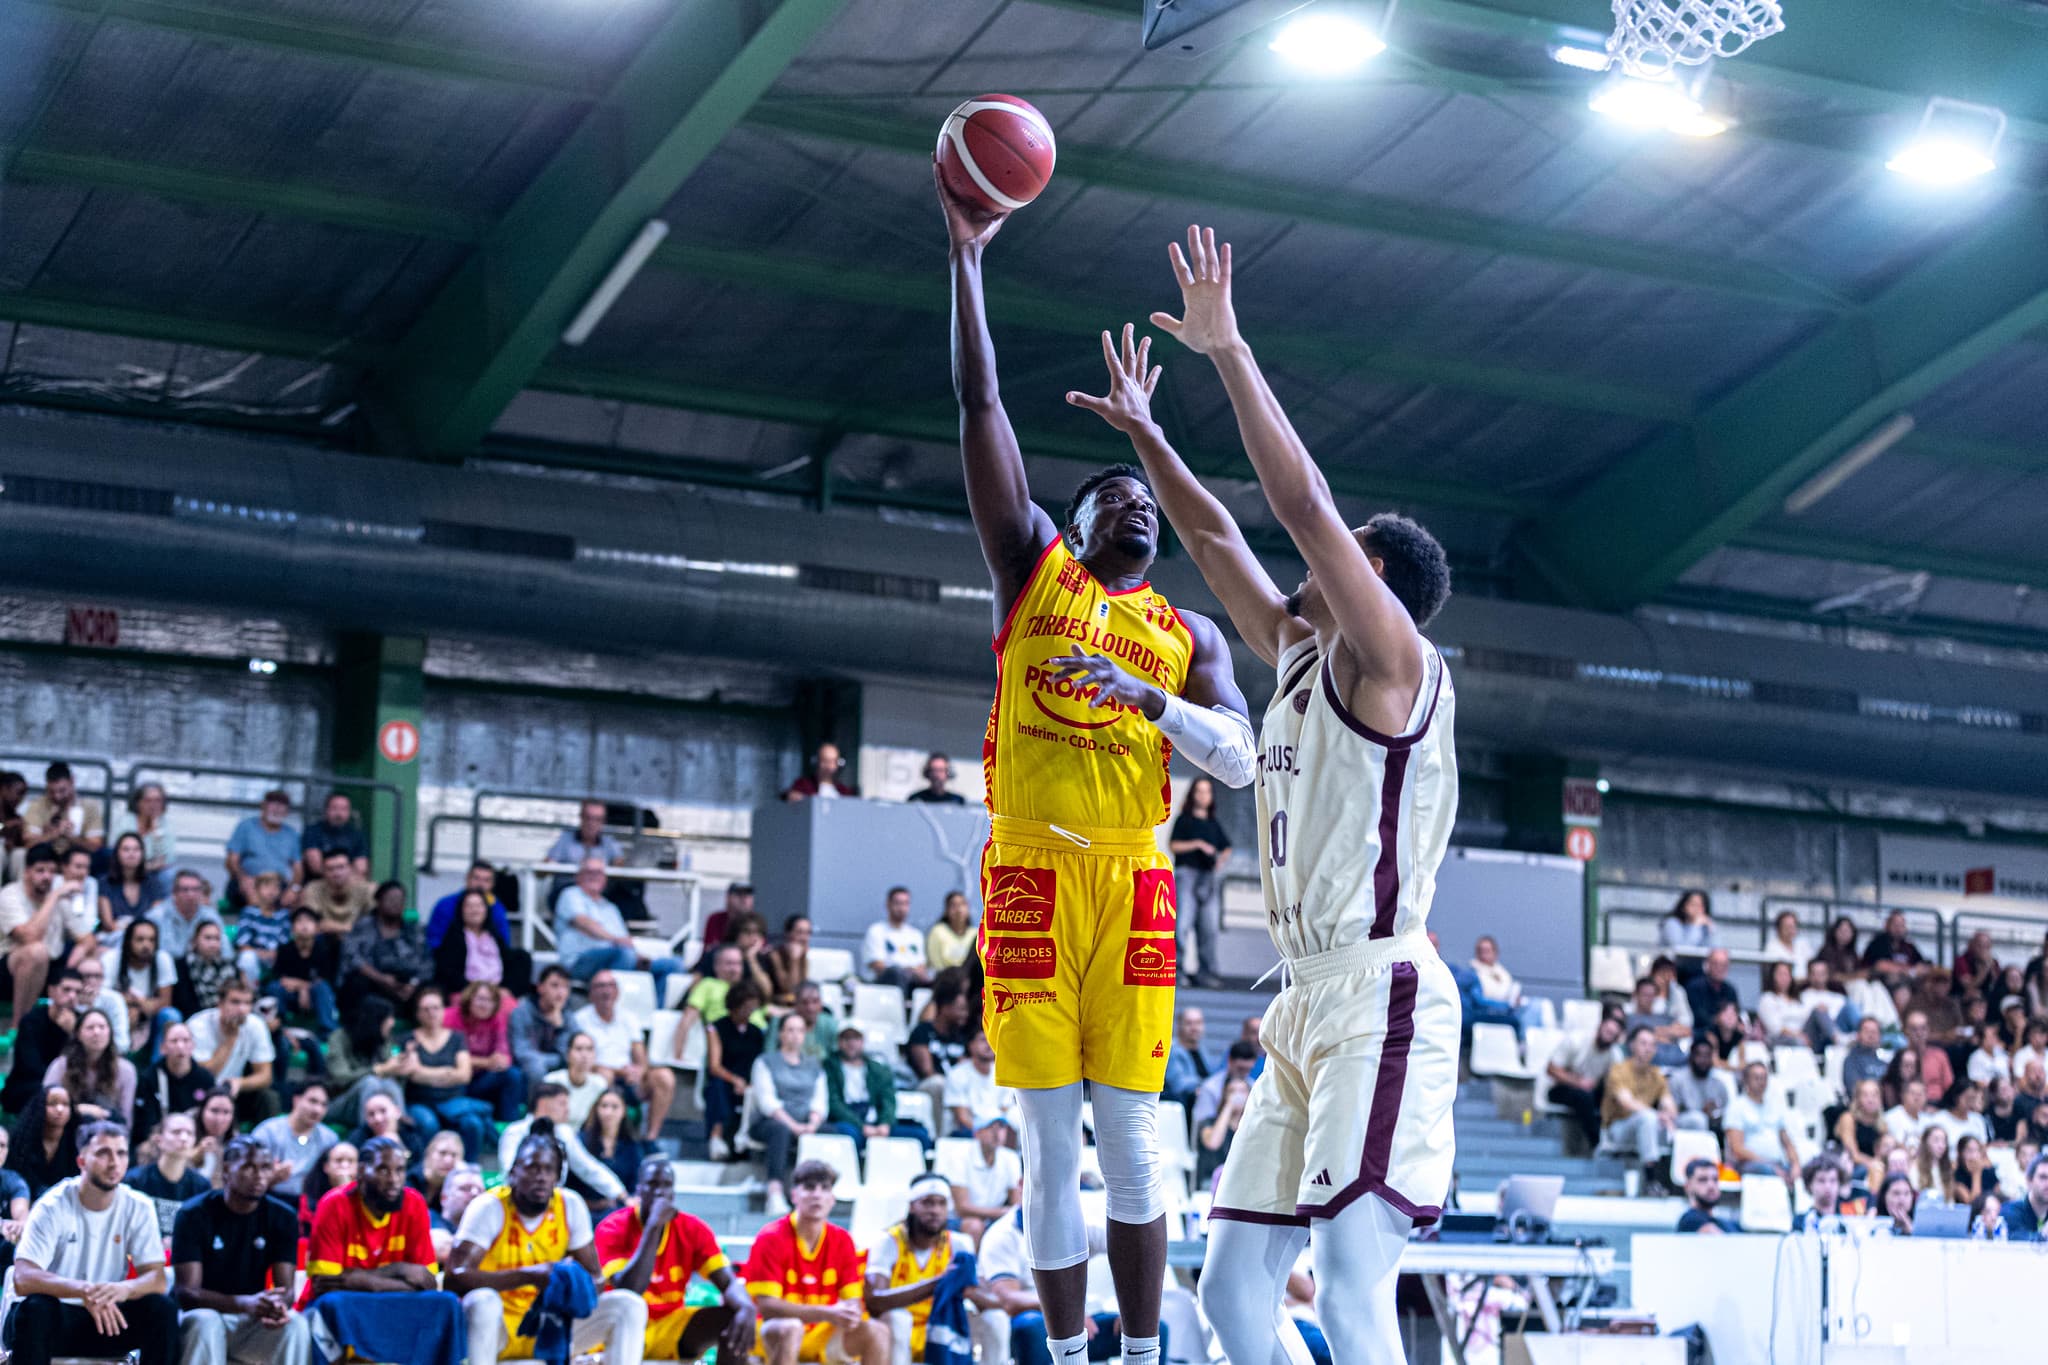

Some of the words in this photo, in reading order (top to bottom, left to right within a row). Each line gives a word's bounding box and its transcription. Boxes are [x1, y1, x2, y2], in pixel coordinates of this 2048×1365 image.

[1024, 614, 1091, 641] TARBES
[1091, 627, 1170, 689] LOURDES
[1018, 722, 1058, 742] Intérim
[1069, 735, 1097, 750] CDD
[1108, 743, 1130, 756] CDI
[994, 910, 1043, 924] TARBES
[998, 947, 1052, 957] LOURDES
[1013, 990, 1057, 999] TRESSENS
